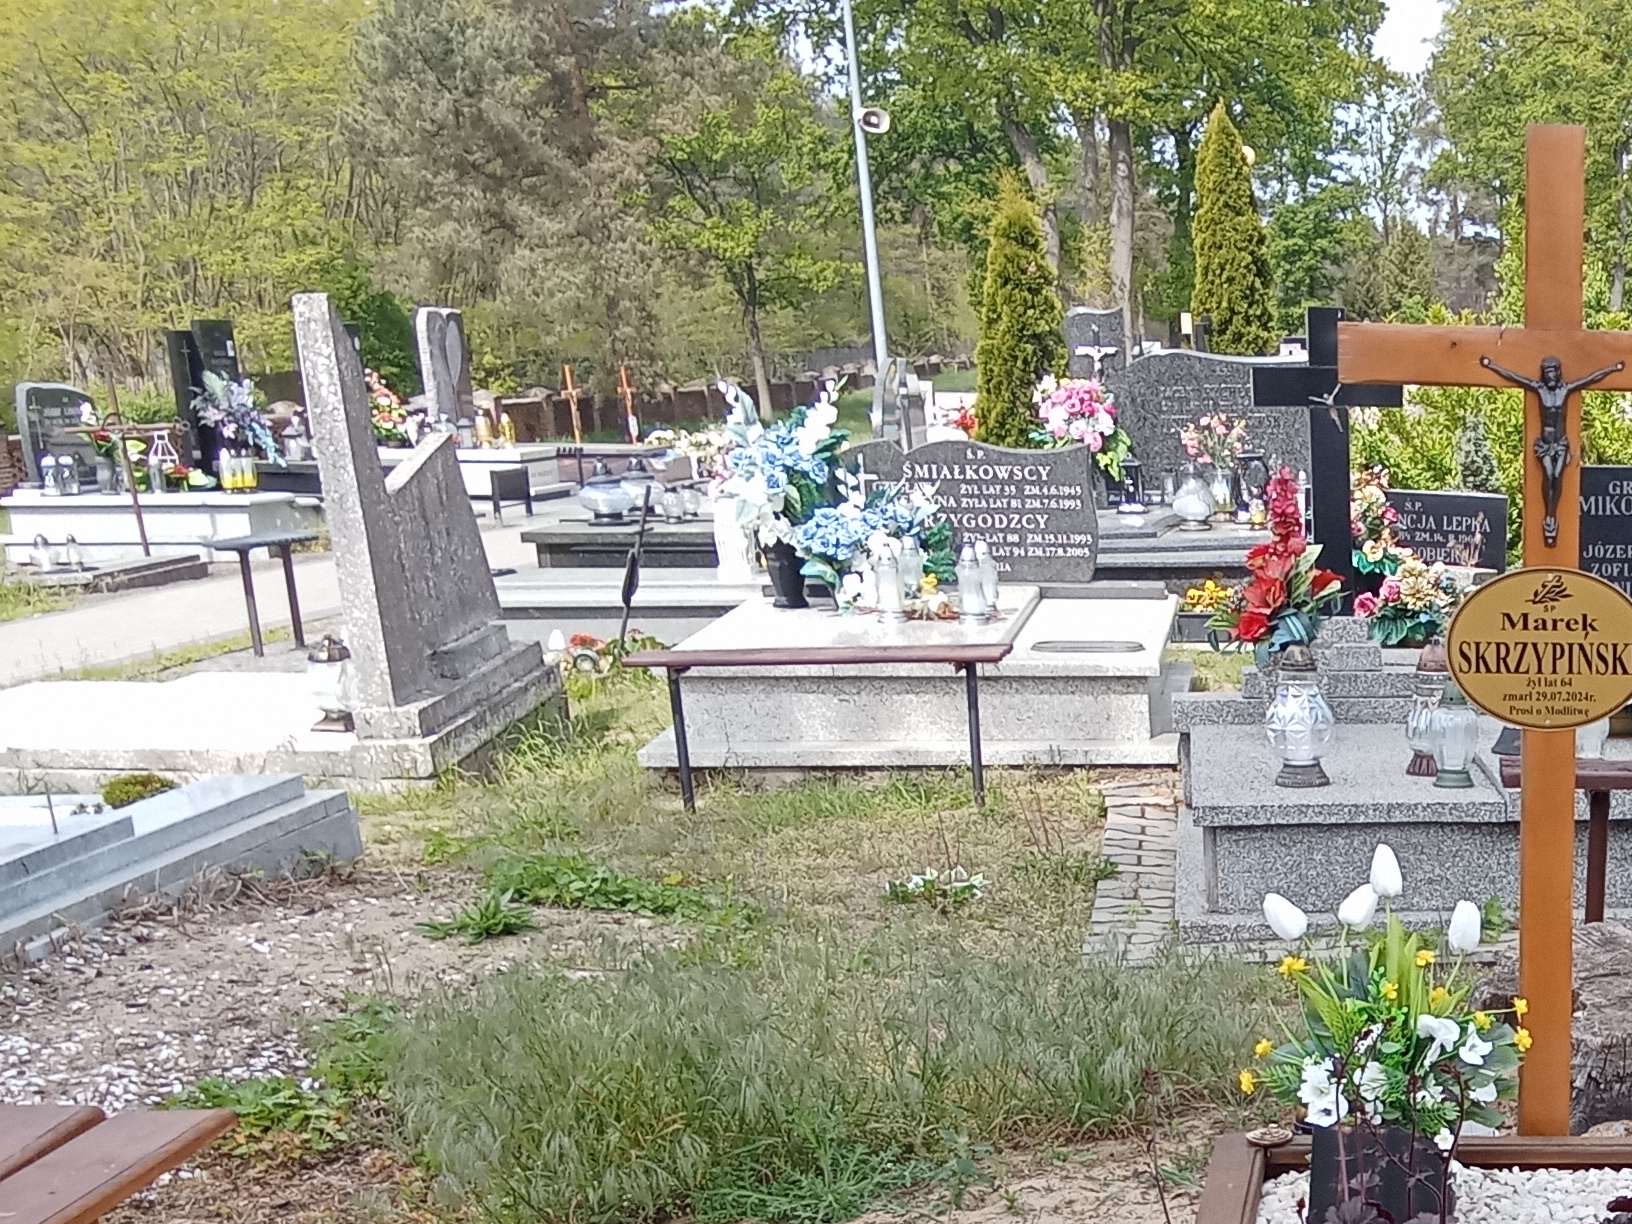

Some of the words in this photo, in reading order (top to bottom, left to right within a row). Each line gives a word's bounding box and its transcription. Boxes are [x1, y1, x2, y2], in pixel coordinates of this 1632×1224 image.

[902, 460, 1051, 481] ŚMIAŁKOWSCY
[982, 484, 1002, 495] LAT
[989, 498, 1009, 508] LAT
[923, 512, 1049, 529] RZYGODZCY
[985, 533, 1005, 543] LAT
[992, 546, 1011, 557] LAT
[1500, 612, 1599, 632] Marek
[1544, 677, 1557, 687] lat
[1560, 677, 1573, 687] 64
[1535, 708, 1543, 716] o
[1545, 705, 1590, 718] Modlitwę
